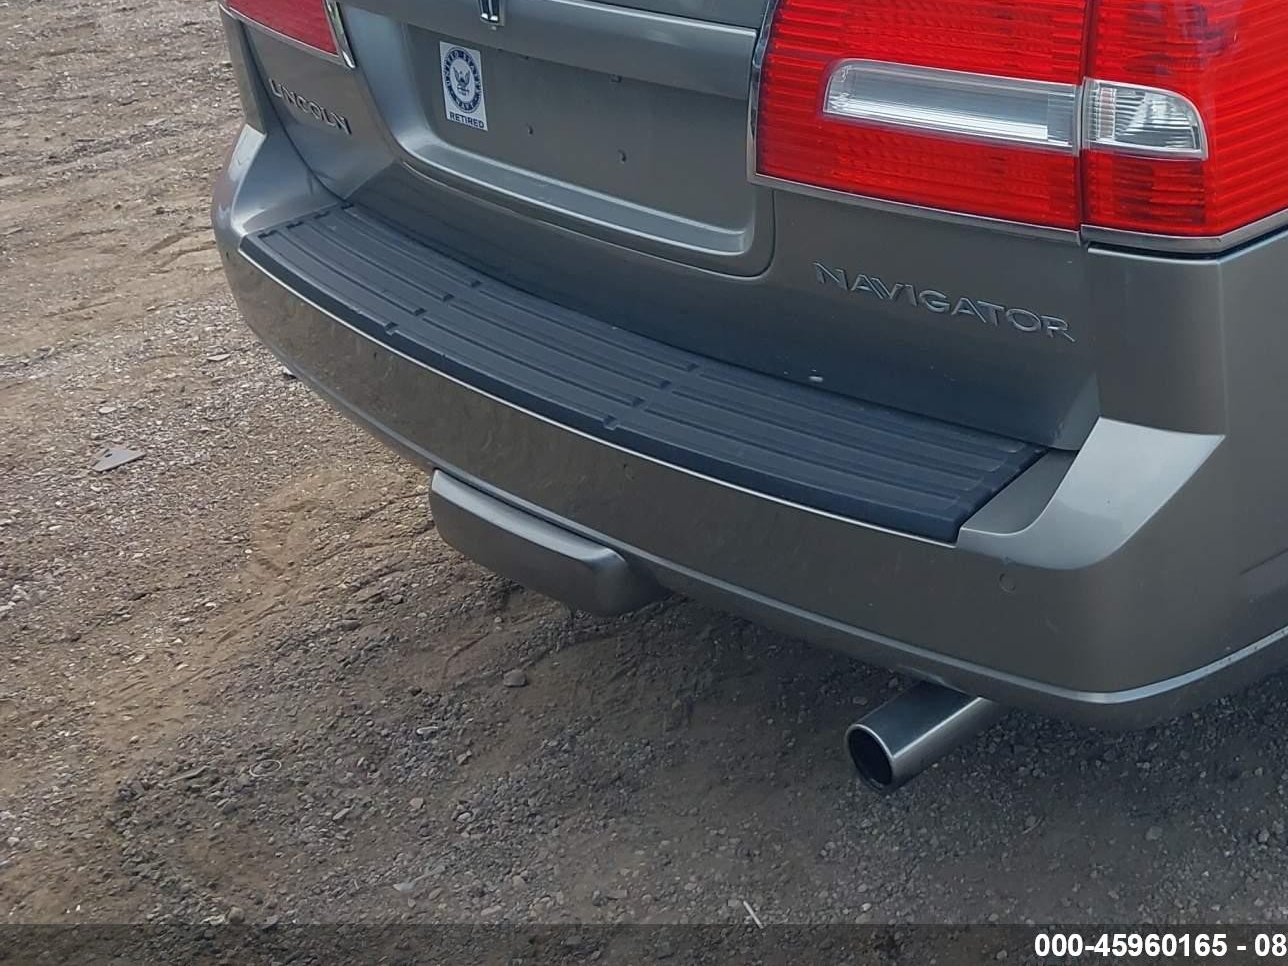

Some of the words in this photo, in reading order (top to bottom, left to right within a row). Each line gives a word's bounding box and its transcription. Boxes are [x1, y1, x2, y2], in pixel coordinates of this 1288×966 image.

[268, 77, 352, 135] LINCOLN
[449, 111, 485, 129] RETIRED
[812, 261, 1076, 342] NAVIGATOR
